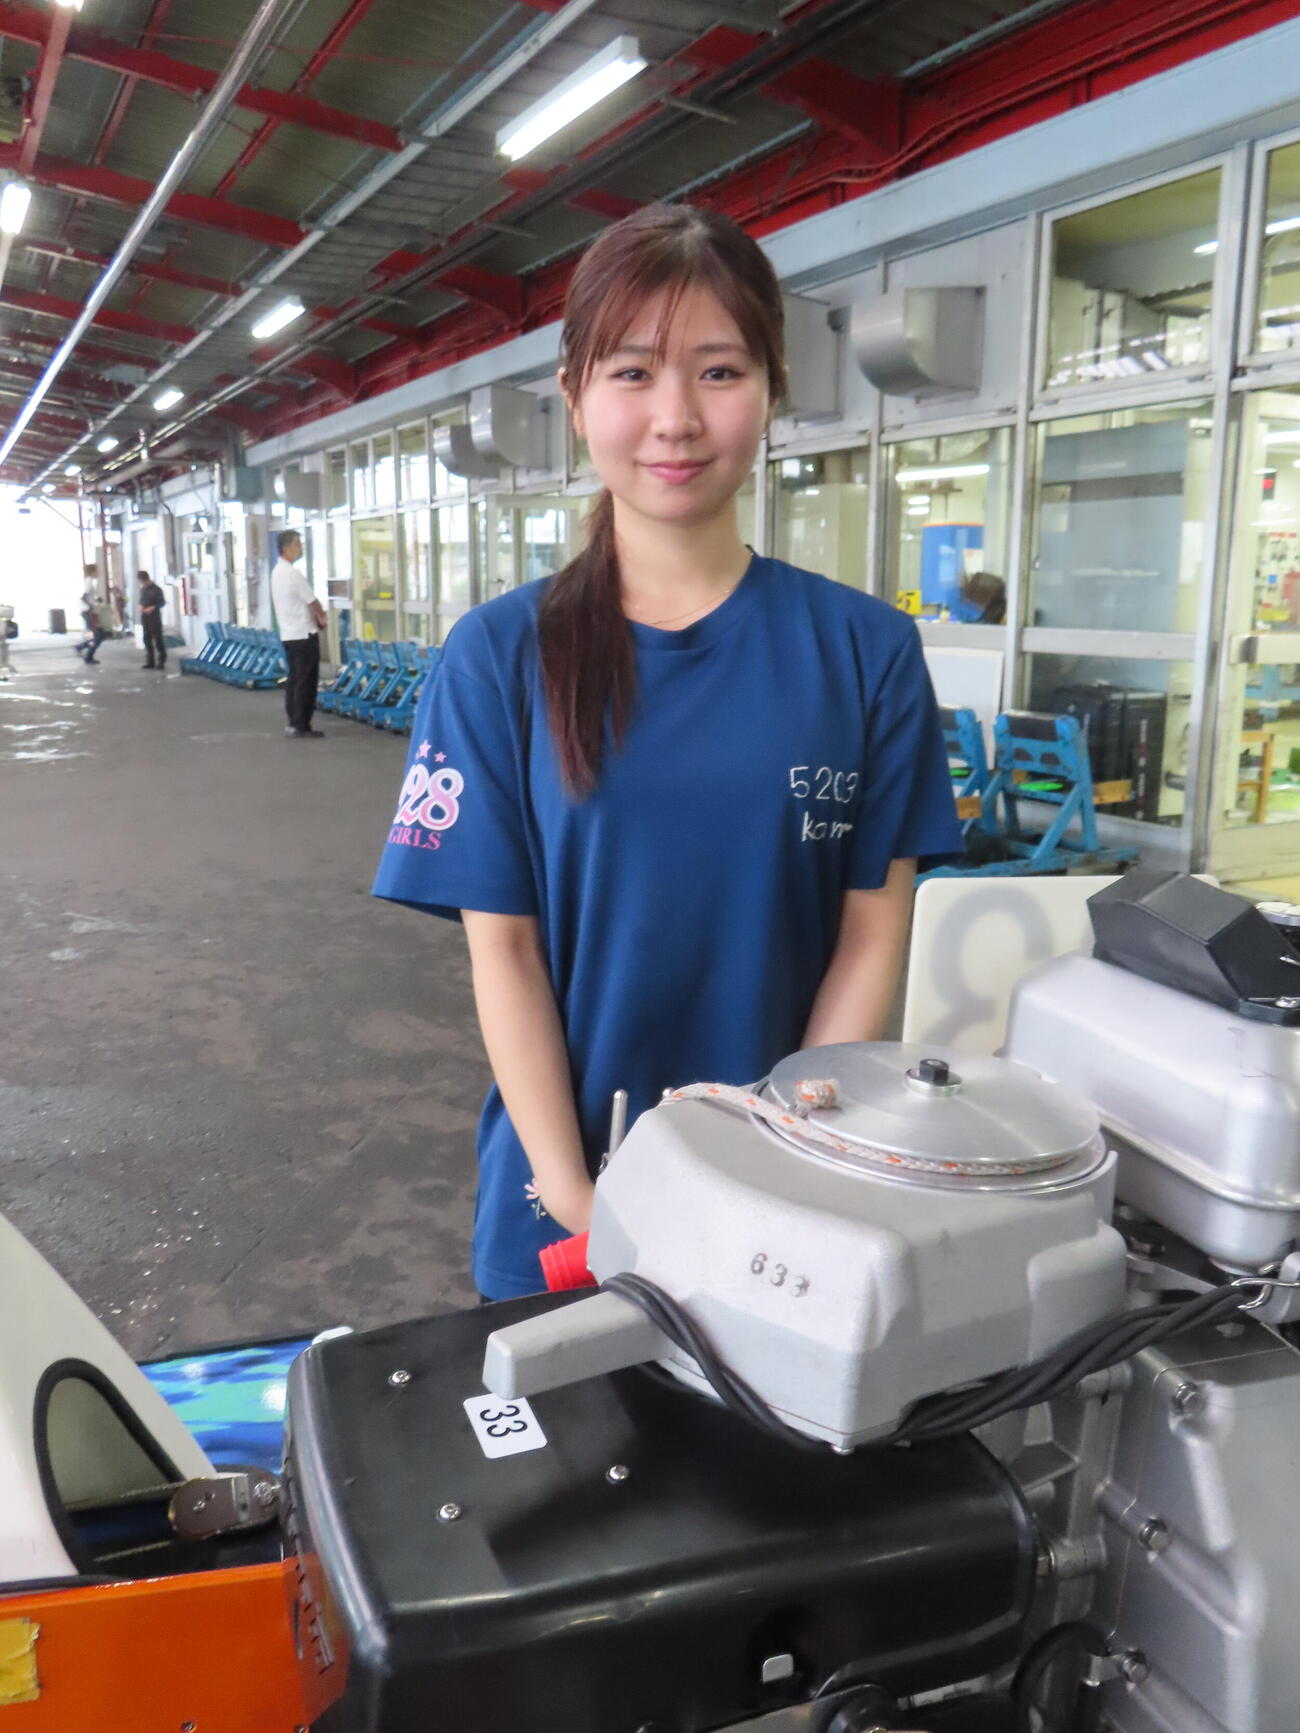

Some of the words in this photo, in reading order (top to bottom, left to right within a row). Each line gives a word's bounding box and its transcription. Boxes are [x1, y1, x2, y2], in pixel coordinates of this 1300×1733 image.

[788, 765, 859, 804] 5203
[387, 826, 443, 851] GIRLS
[479, 1404, 529, 1438] 33
